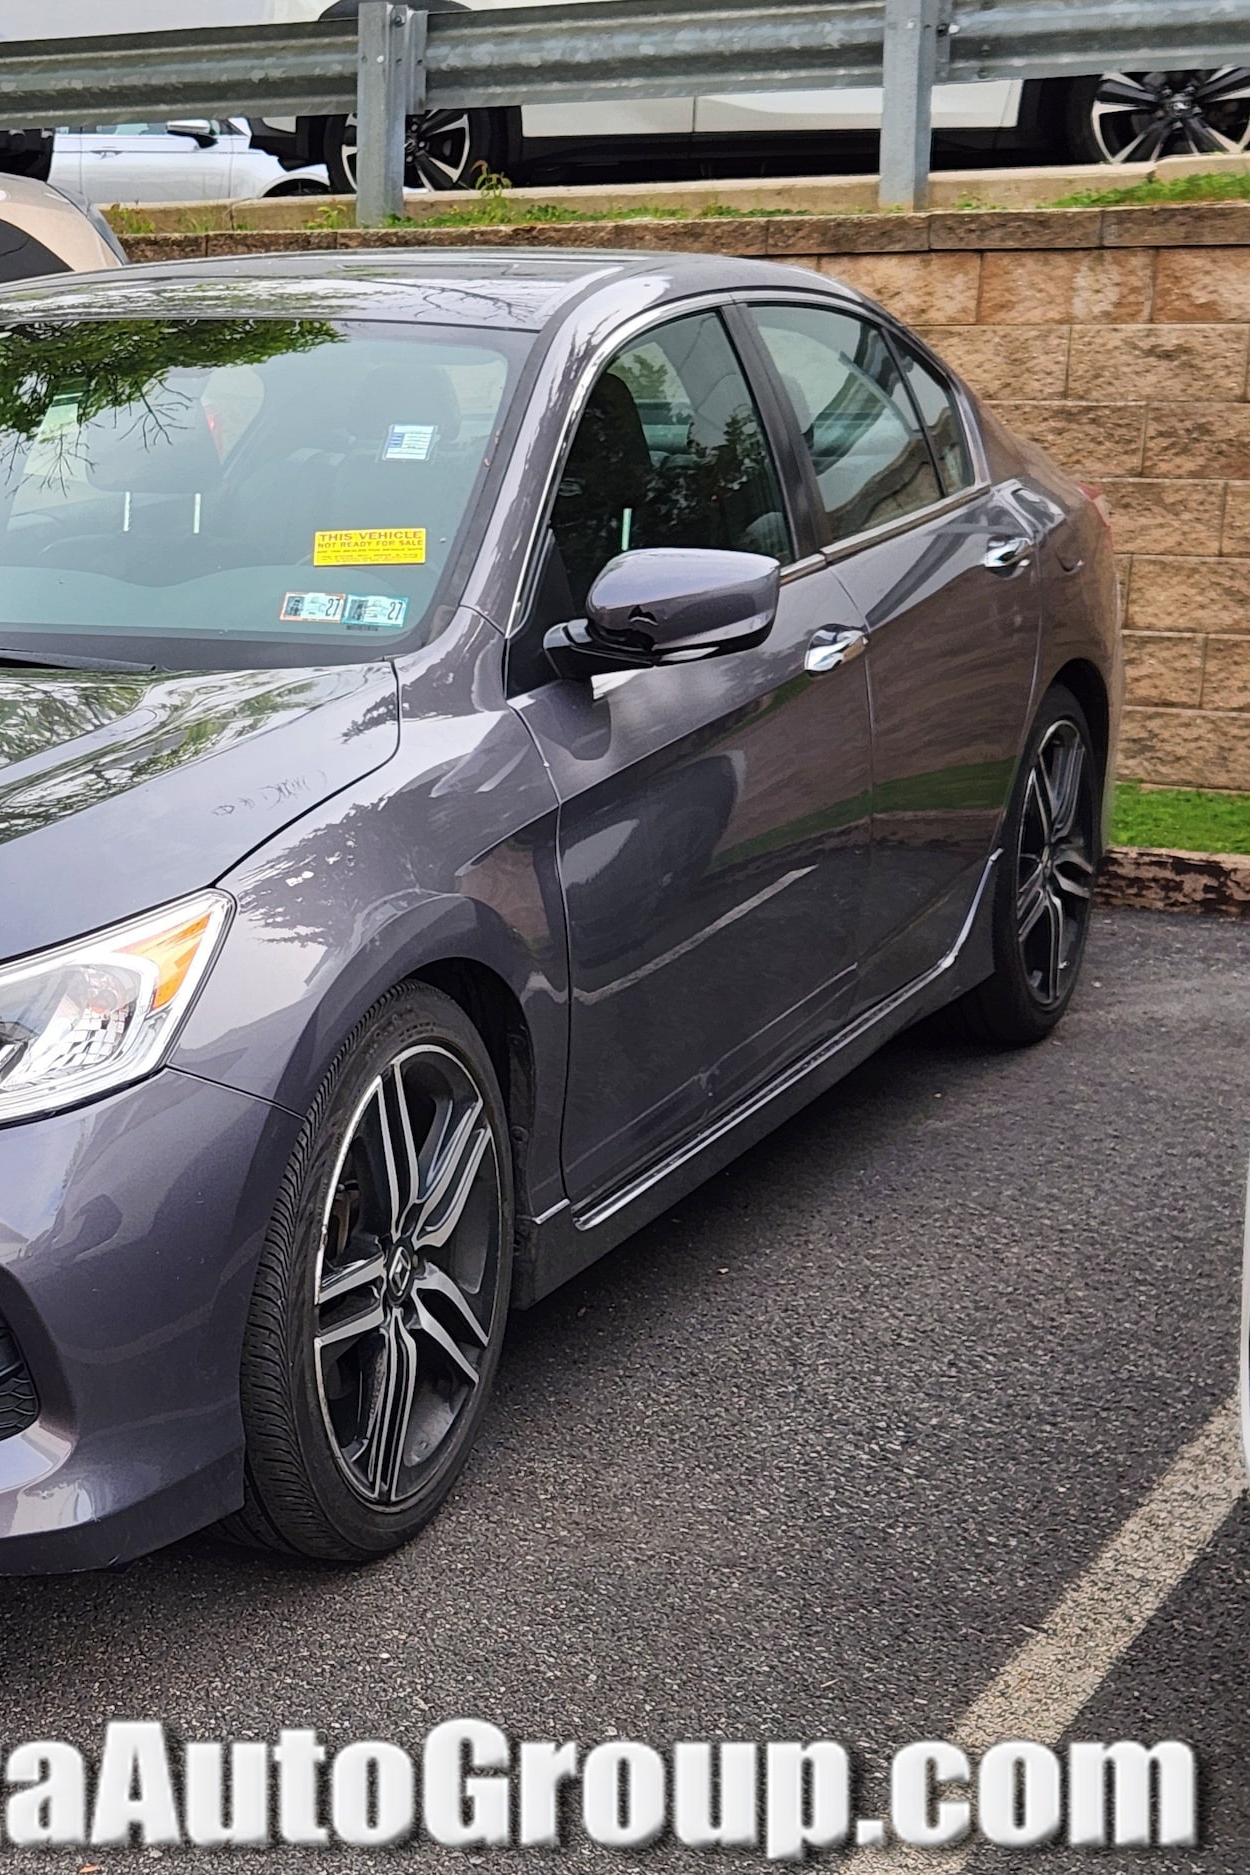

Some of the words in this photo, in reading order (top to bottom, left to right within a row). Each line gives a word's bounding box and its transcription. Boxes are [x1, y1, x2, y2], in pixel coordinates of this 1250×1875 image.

[319, 532, 354, 542] THIS
[358, 530, 423, 541] VEHICLE
[399, 539, 423, 547] SALE
[325, 597, 342, 618] 27
[387, 601, 404, 622] 27
